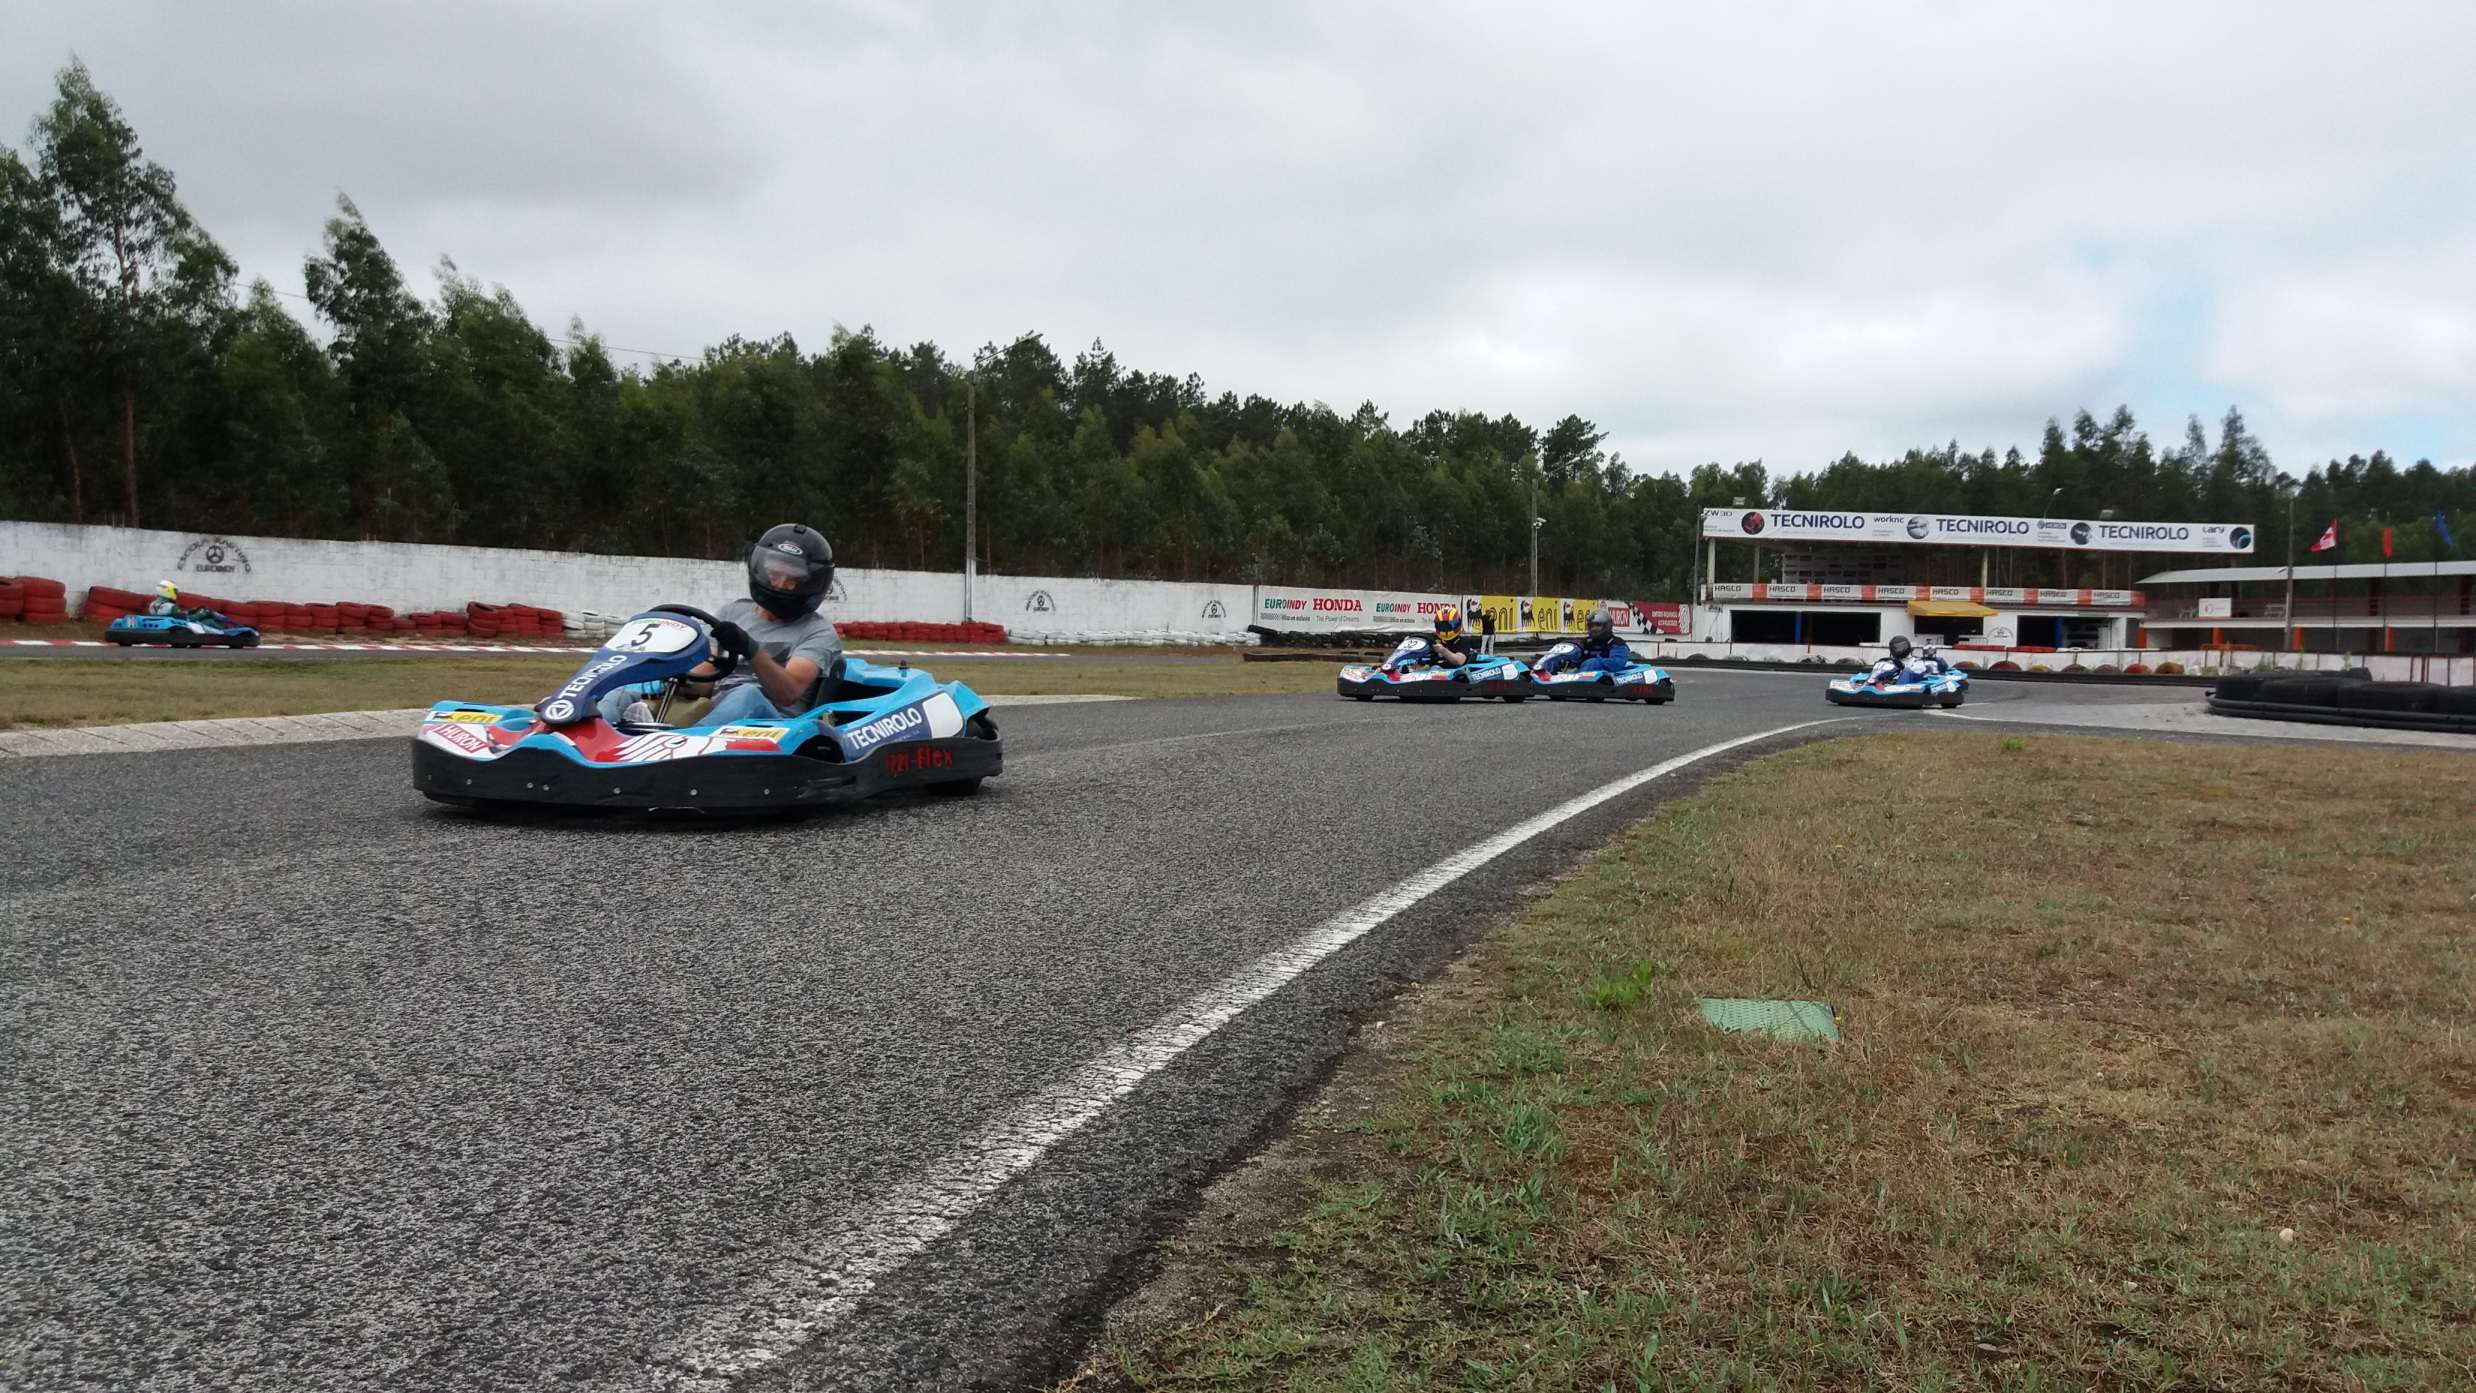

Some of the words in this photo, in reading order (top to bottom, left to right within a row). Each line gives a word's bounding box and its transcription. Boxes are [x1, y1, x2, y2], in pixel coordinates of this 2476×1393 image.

[1771, 514, 1865, 529] TECNIROLO
[1936, 518, 2029, 534] TECNIROLO
[2099, 525, 2189, 541] TECNIROLO
[1878, 587, 1905, 595] HASCO
[1932, 588, 1959, 596] HASCO
[1986, 589, 2013, 597] HASCO
[1264, 599, 1307, 610] EUROINDY
[1312, 599, 1363, 612] HONDA
[1376, 603, 1411, 613] EUROINDY
[1537, 600, 1558, 631] eni
[630, 623, 661, 647] 5
[848, 707, 923, 750] TECNIROLO
[442, 724, 485, 750] HURON
